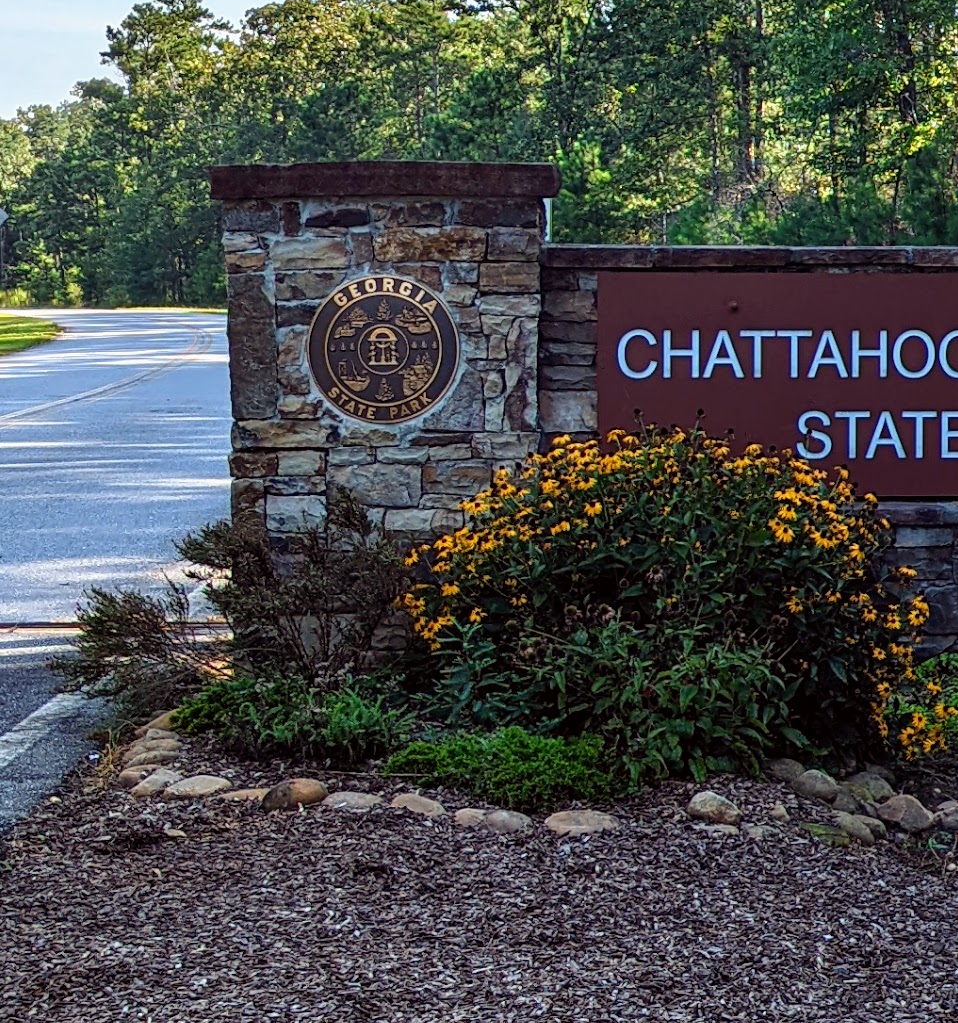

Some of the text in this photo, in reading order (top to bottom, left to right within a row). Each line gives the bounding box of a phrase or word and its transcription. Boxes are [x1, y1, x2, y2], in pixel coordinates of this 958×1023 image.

[333, 278, 439, 316] GEORGIA
[328, 387, 433, 420] STATE PARK
